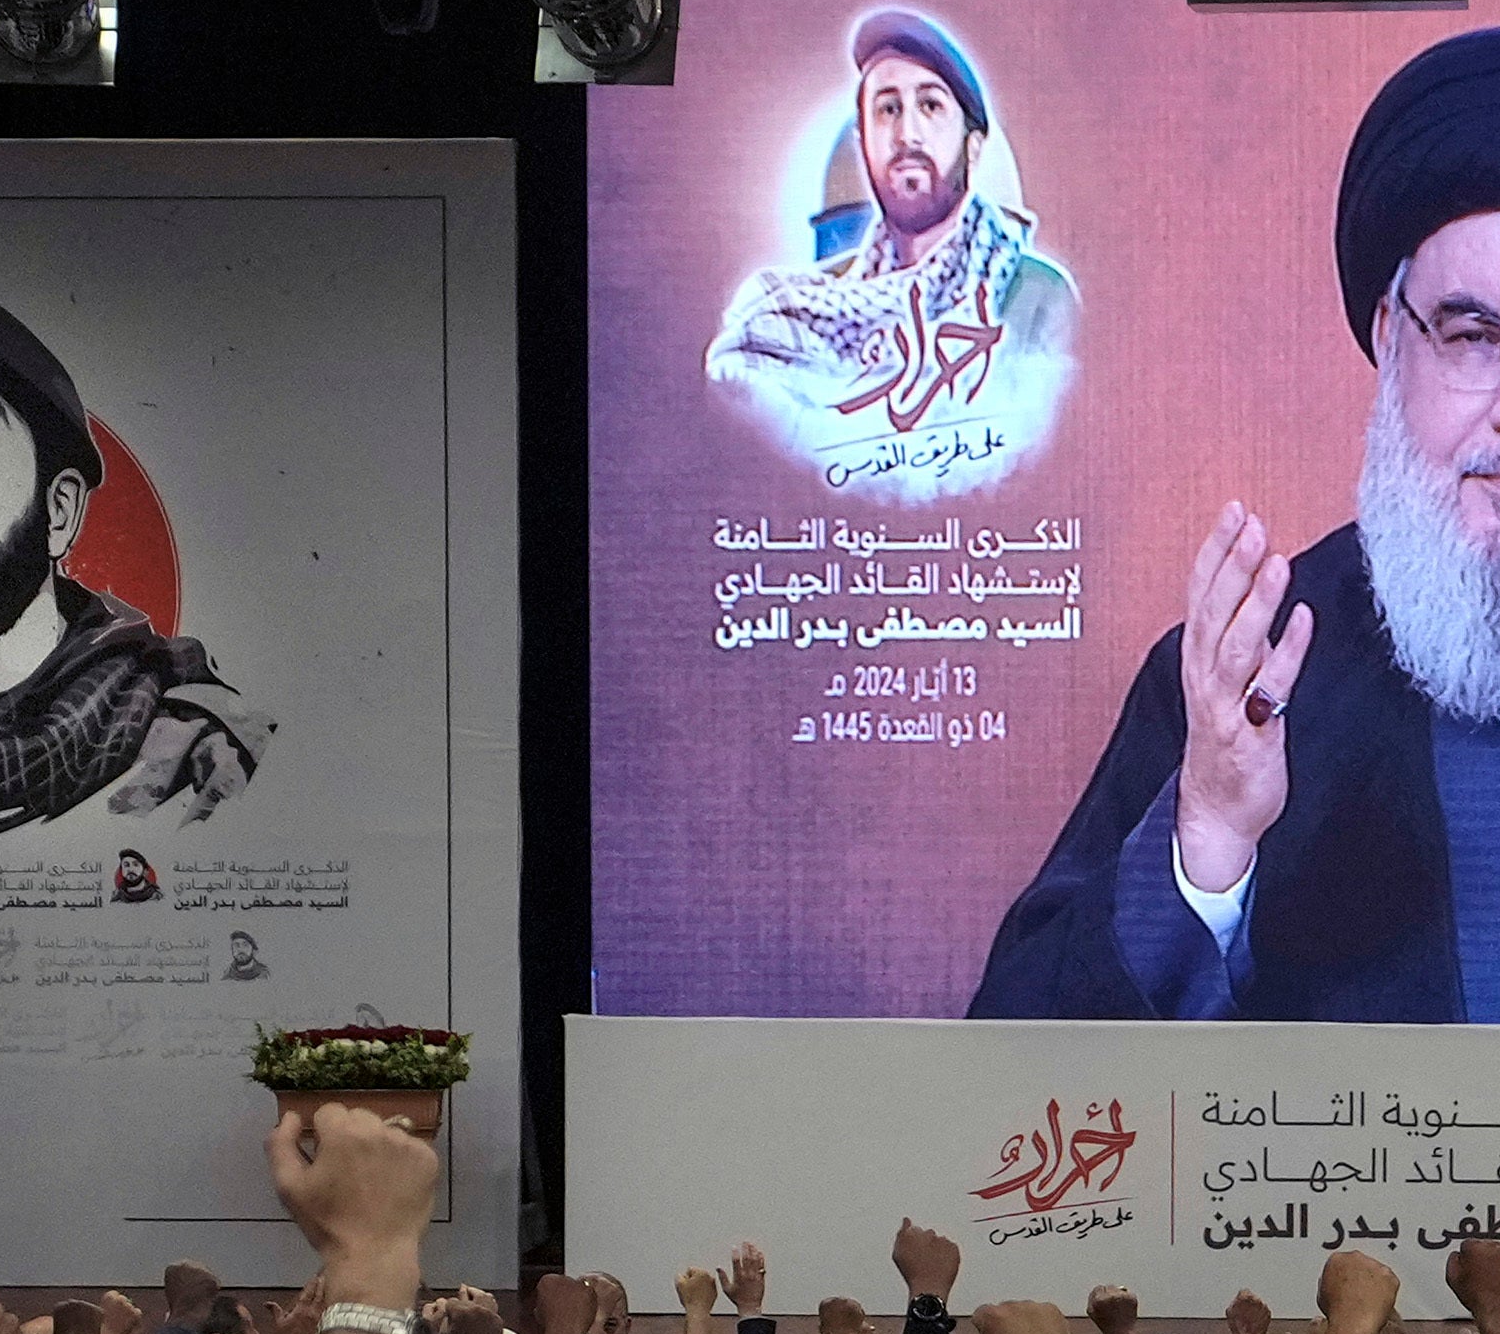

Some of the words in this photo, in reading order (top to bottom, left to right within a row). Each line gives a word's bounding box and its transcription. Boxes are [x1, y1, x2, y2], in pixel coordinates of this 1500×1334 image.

[911, 430, 968, 478] طريق
[968, 427, 1005, 461] على
[826, 443, 906, 488] القدس
[713, 517, 825, 550] الثامنة
[832, 517, 960, 557] السنوية
[967, 517, 1081, 558] الذكرى
[715, 562, 841, 609] الجهادي
[849, 561, 939, 595] القائد
[715, 607, 789, 648] الدين
[794, 617, 849, 649] بدر
[857, 607, 988, 647] مصطفى
[996, 607, 1081, 647] السيد
[854, 665, 906, 697] 2024
[953, 665, 977, 696] 13
[823, 711, 872, 741] 1445
[877, 711, 942, 742] القعدة
[947, 712, 974, 747] ذو
[979, 710, 1006, 740] 04
[62, 896, 102, 911] السيد
[174, 895, 207, 911] الدين
[211, 898, 235, 911] بدر
[240, 894, 303, 910] مصطفى
[309, 896, 348, 911] السيد
[1201, 1090, 1366, 1127] الثامنة
[1203, 1147, 1388, 1202] الجهادي
[989, 1217, 1053, 1245] القدس
[1056, 1208, 1103, 1240] طريق
[1102, 1207, 1134, 1229] على
[1203, 1202, 1309, 1249] الدين
[1322, 1213, 1399, 1249] بدر
